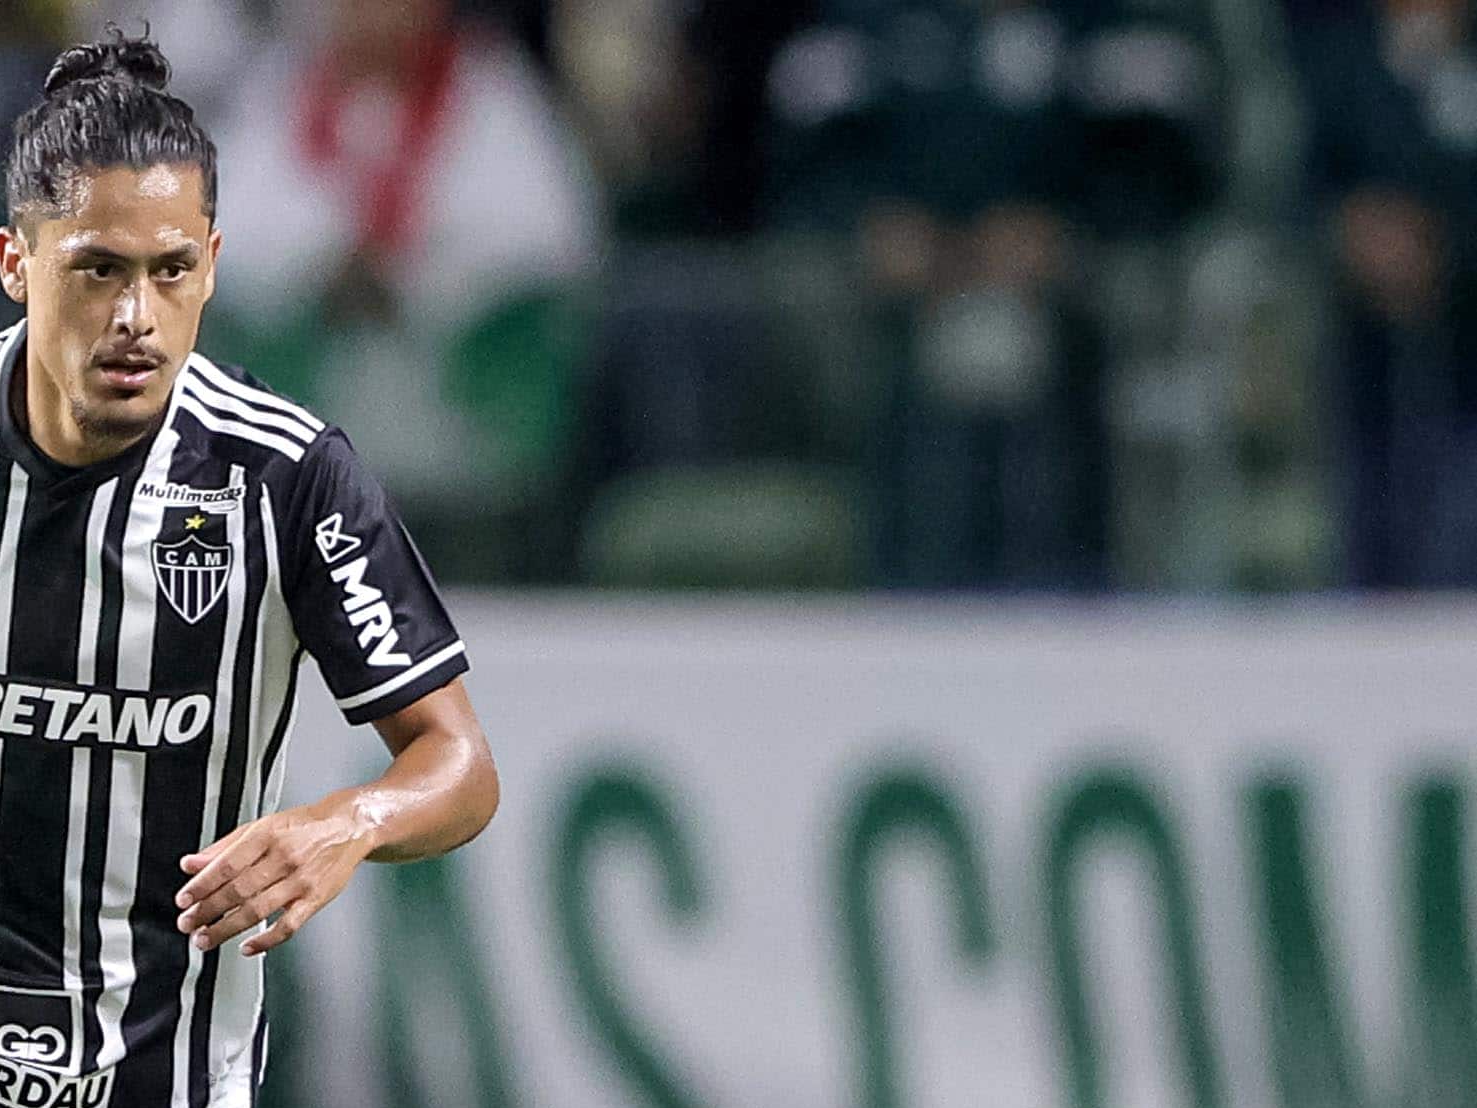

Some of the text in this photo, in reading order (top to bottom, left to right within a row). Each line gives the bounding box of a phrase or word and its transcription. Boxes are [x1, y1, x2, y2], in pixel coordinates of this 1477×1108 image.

[138, 482, 243, 502] Multimarcas
[164, 550, 221, 567] CAM
[330, 556, 412, 667] MRV
